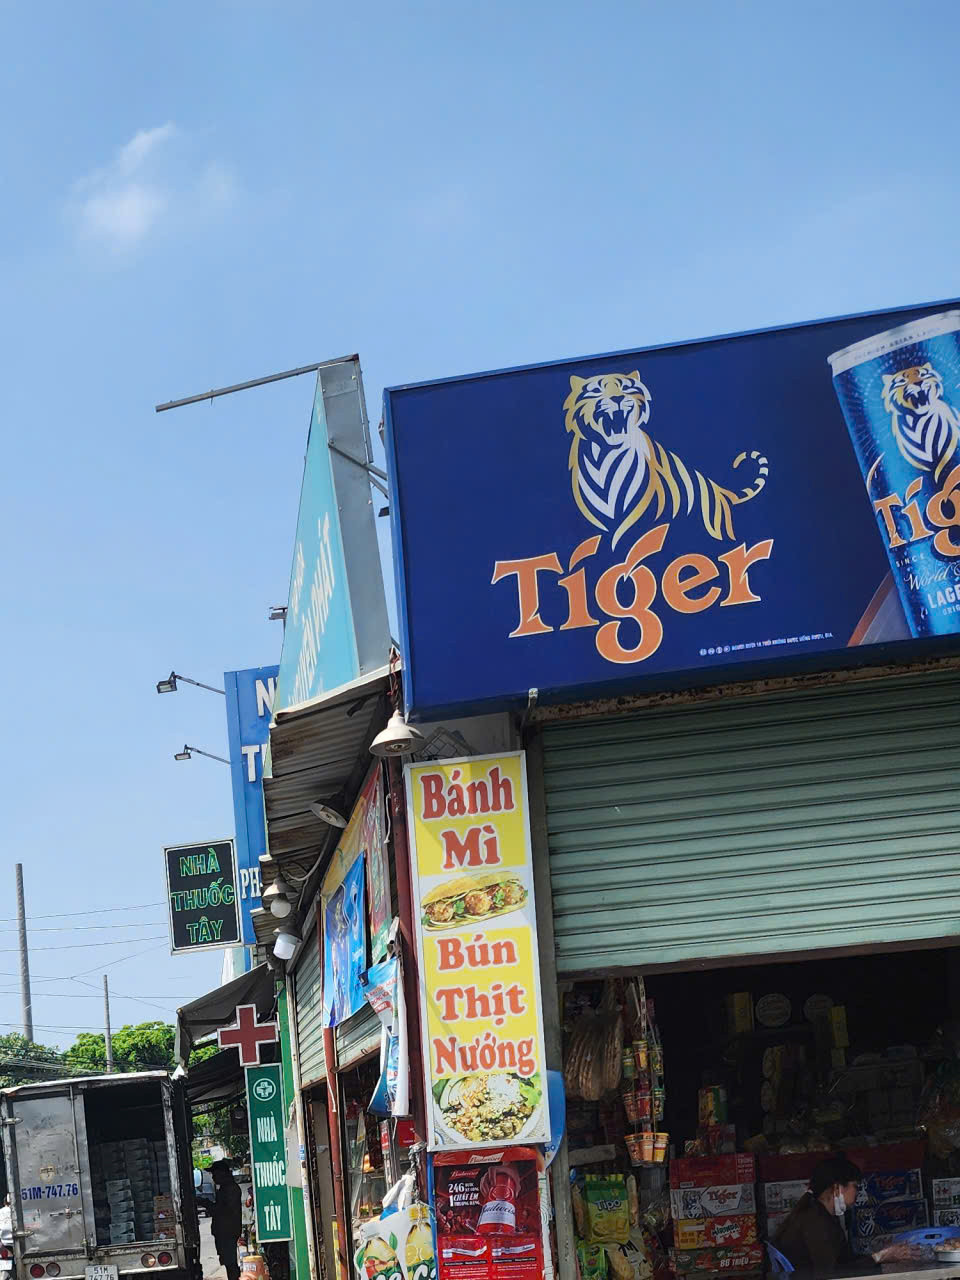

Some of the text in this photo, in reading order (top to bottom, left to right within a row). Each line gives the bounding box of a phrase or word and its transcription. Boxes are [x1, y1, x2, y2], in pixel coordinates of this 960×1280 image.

[491, 524, 774, 664] Tiger
[255, 677, 279, 717] N
[420, 767, 514, 820] Bánh
[179, 848, 220, 877] NHÀ
[441, 824, 501, 869] Mì
[171, 877, 235, 912] THUỐC
[240, 868, 263, 899] PH
[186, 916, 224, 943] TÂY
[437, 934, 517, 970] Bún
[435, 983, 525, 1026] Thịt
[433, 1032, 535, 1076] Nướng
[256, 1113, 277, 1143] NHÀ
[255, 1152, 285, 1187] THUỐC
[21, 1183, 79, 1200] 51M-747.76
[448, 1183, 464, 1193] 246
[264, 1201, 281, 1231] TÂY
[595, 1199, 621, 1211] Tipo
[93, 1266, 108, 1274] 51M
